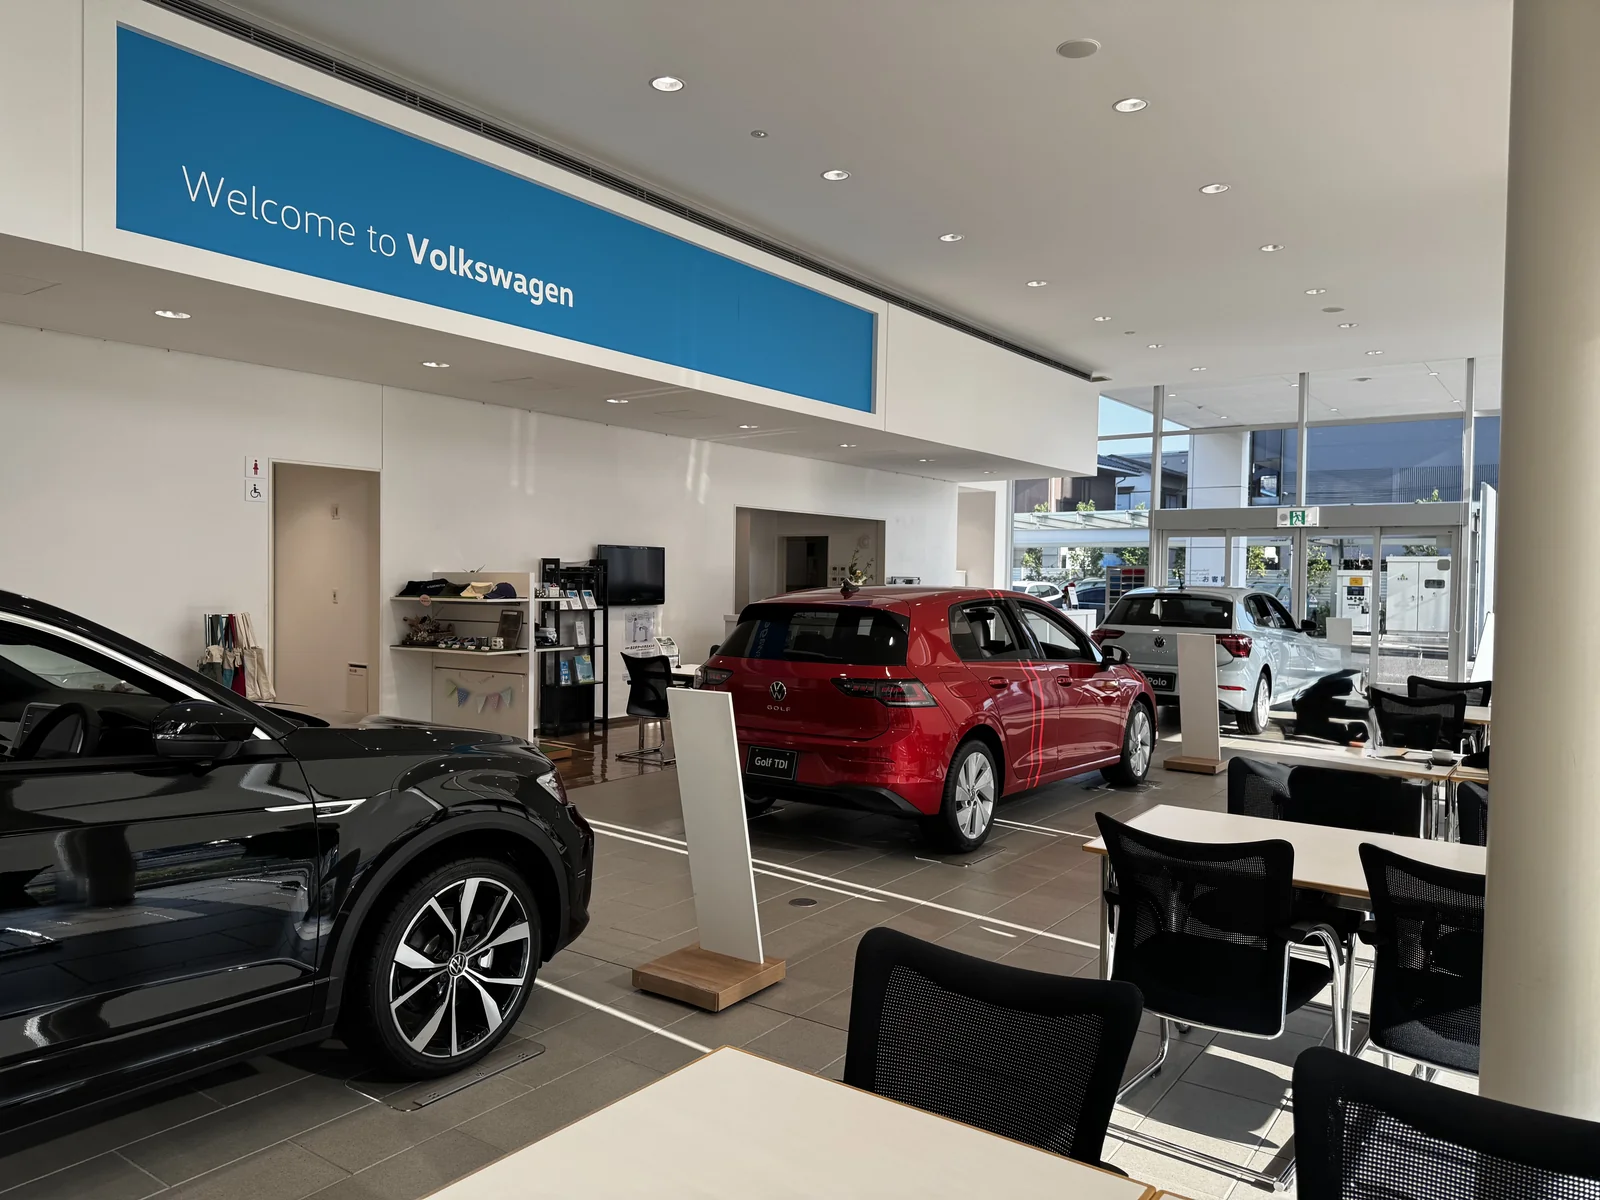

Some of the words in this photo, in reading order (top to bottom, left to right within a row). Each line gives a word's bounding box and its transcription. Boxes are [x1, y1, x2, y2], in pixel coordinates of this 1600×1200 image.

[182, 165, 356, 246] Welcome
[366, 225, 397, 257] to
[407, 233, 575, 307] Volkswagen
[766, 704, 792, 712] GOLF
[754, 756, 773, 768] Golf
[774, 759, 789, 770] TDI
